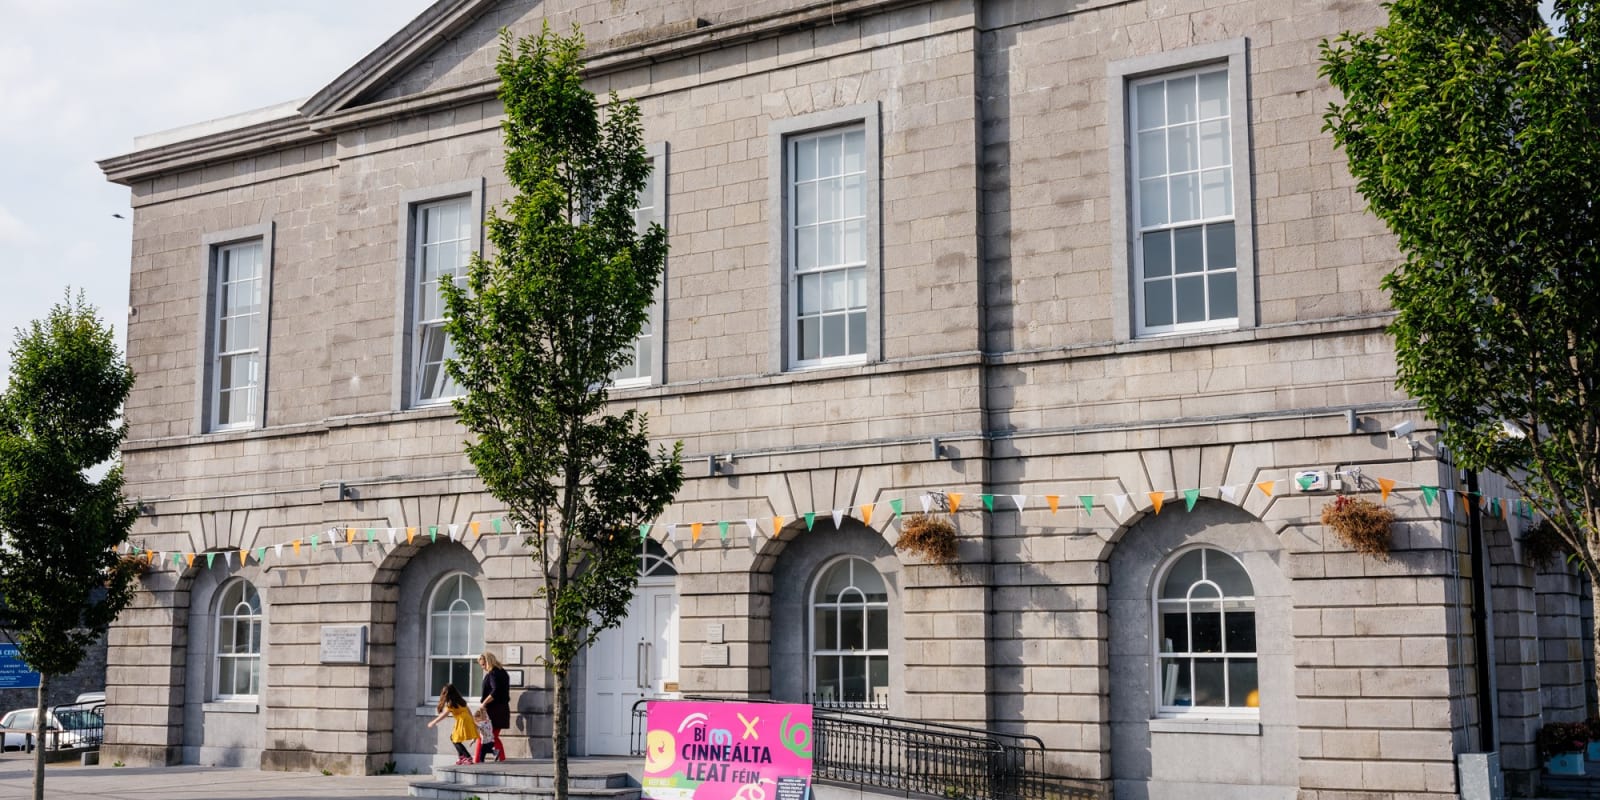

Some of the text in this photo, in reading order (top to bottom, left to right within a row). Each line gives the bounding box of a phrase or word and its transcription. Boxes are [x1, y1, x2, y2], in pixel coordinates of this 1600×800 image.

[694, 724, 707, 742] BÍ
[682, 742, 772, 764] CINNEÁLTA
[686, 762, 764, 786] LEAT FÉIN,
